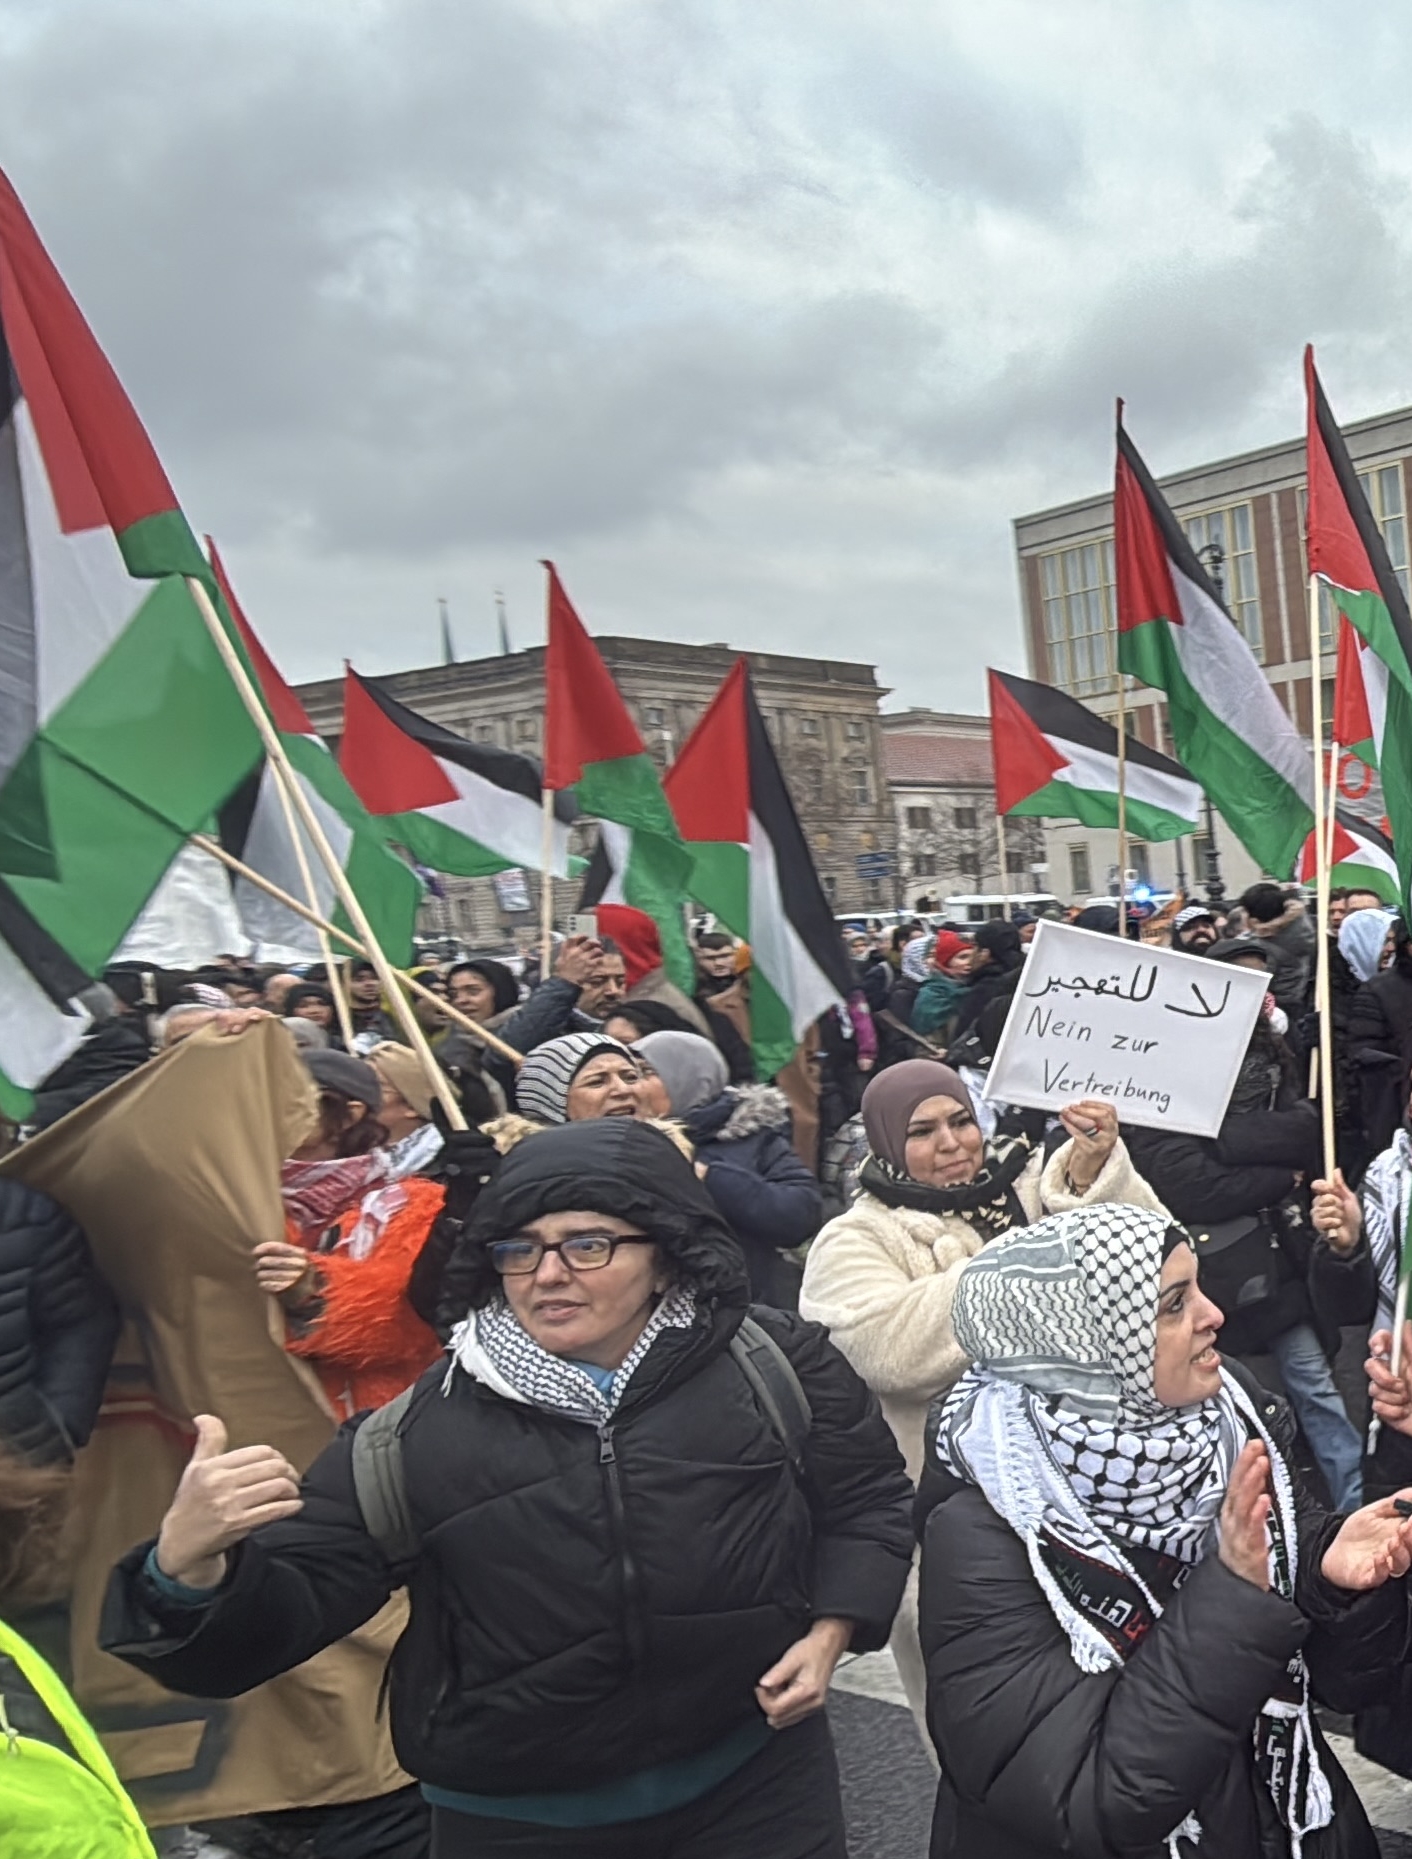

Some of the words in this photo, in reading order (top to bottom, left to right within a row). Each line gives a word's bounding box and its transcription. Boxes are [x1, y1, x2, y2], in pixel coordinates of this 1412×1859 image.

[1024, 964, 1158, 1003] للتهجير
[1164, 979, 1232, 1019] لا
[1024, 1005, 1092, 1043] Nein
[1111, 1033, 1159, 1055] zur
[1043, 1058, 1172, 1113] Vertreibung
